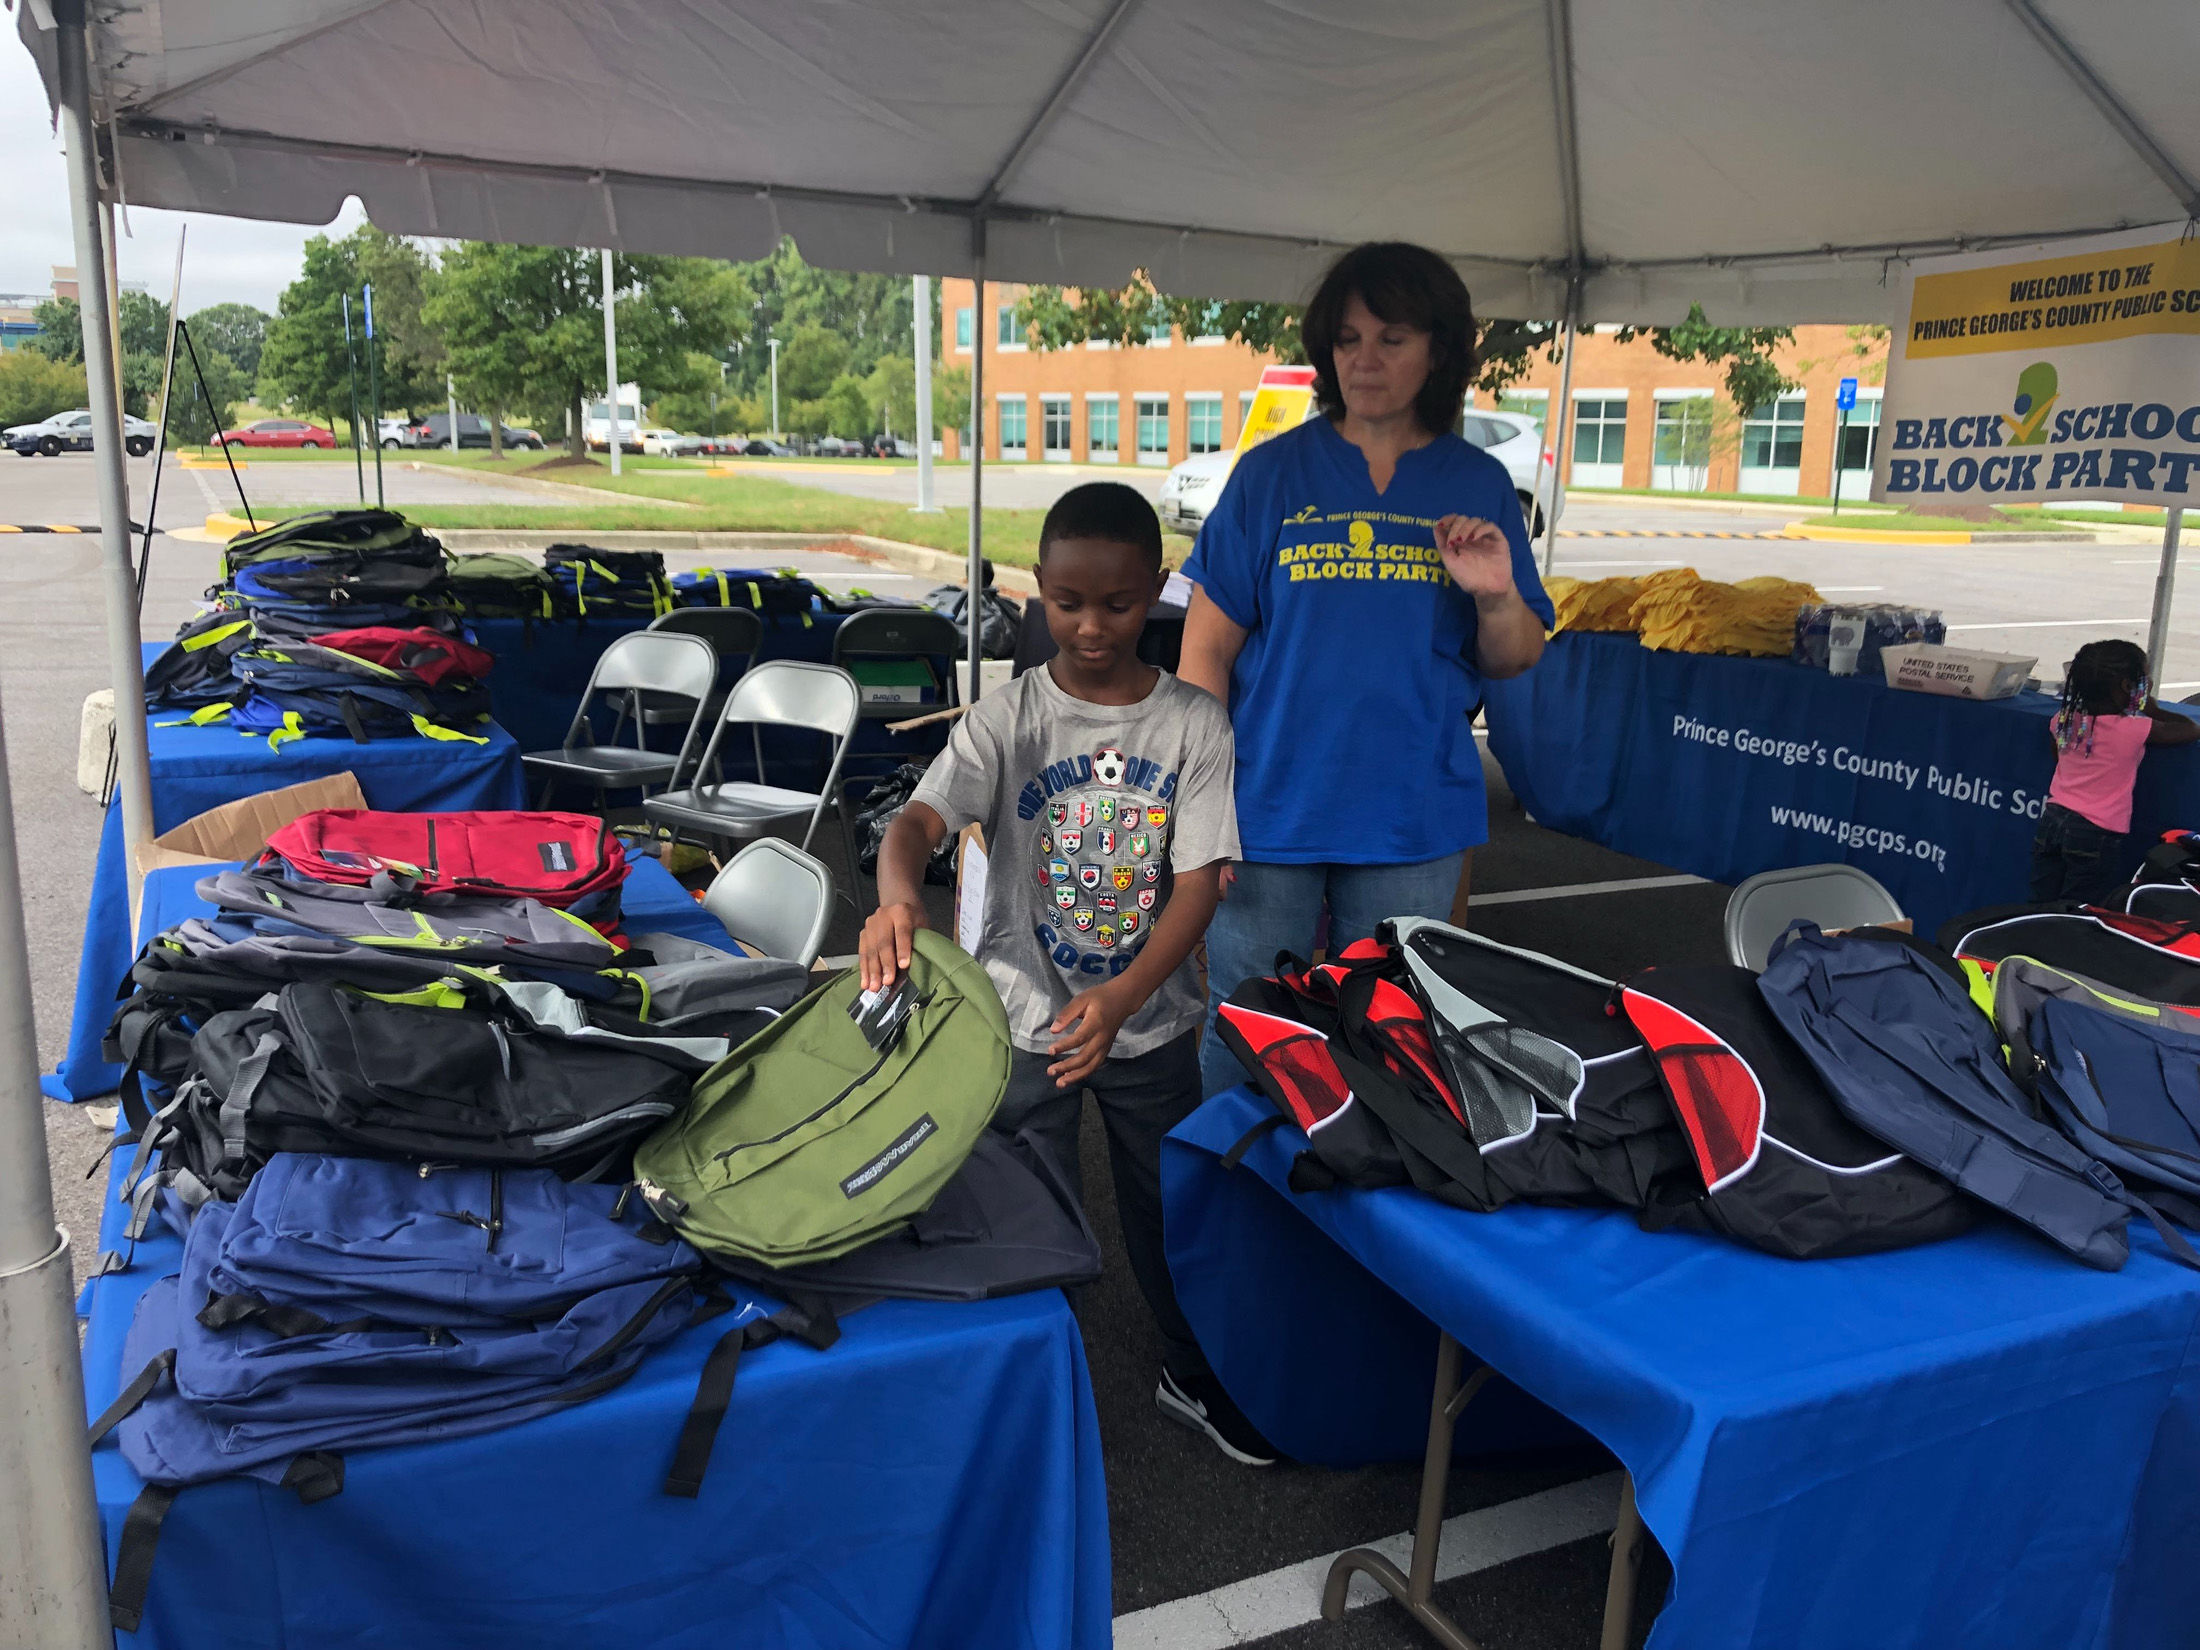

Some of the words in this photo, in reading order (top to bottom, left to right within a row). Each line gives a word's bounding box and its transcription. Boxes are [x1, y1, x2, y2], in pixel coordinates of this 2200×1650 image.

[2010, 272, 2094, 303] WELCOME
[2098, 270, 2121, 293] TO
[2124, 263, 2154, 288] THE
[1914, 317, 1966, 341] PRINCE
[1970, 308, 2042, 336] GEORGE'S
[2045, 299, 2112, 328] COUNTY
[2111, 291, 2167, 321] PUBLIC
[1893, 415, 2005, 449] BACK
[1886, 454, 2043, 493] BLOCK
[2046, 449, 2200, 493] PART
[1388, 513, 1415, 525] COUNTY
[1279, 543, 1344, 566] BACK
[1290, 561, 1373, 582] BLOCK
[1899, 666, 1931, 679] POSTAL
[1935, 671, 1974, 683] SERVICE
[1903, 657, 1934, 669] UNITED
[1937, 662, 1969, 673] STATES
[1673, 715, 1729, 747] Prince
[1734, 728, 1826, 765] George's
[1833, 747, 1920, 790] County
[1927, 766, 2002, 810] Public
[1018, 780, 1046, 820] ONE
[1125, 756, 1163, 792] ONE
[1771, 804, 1947, 873] www.pgcps.org
[1034, 922, 1145, 976] SOCC
